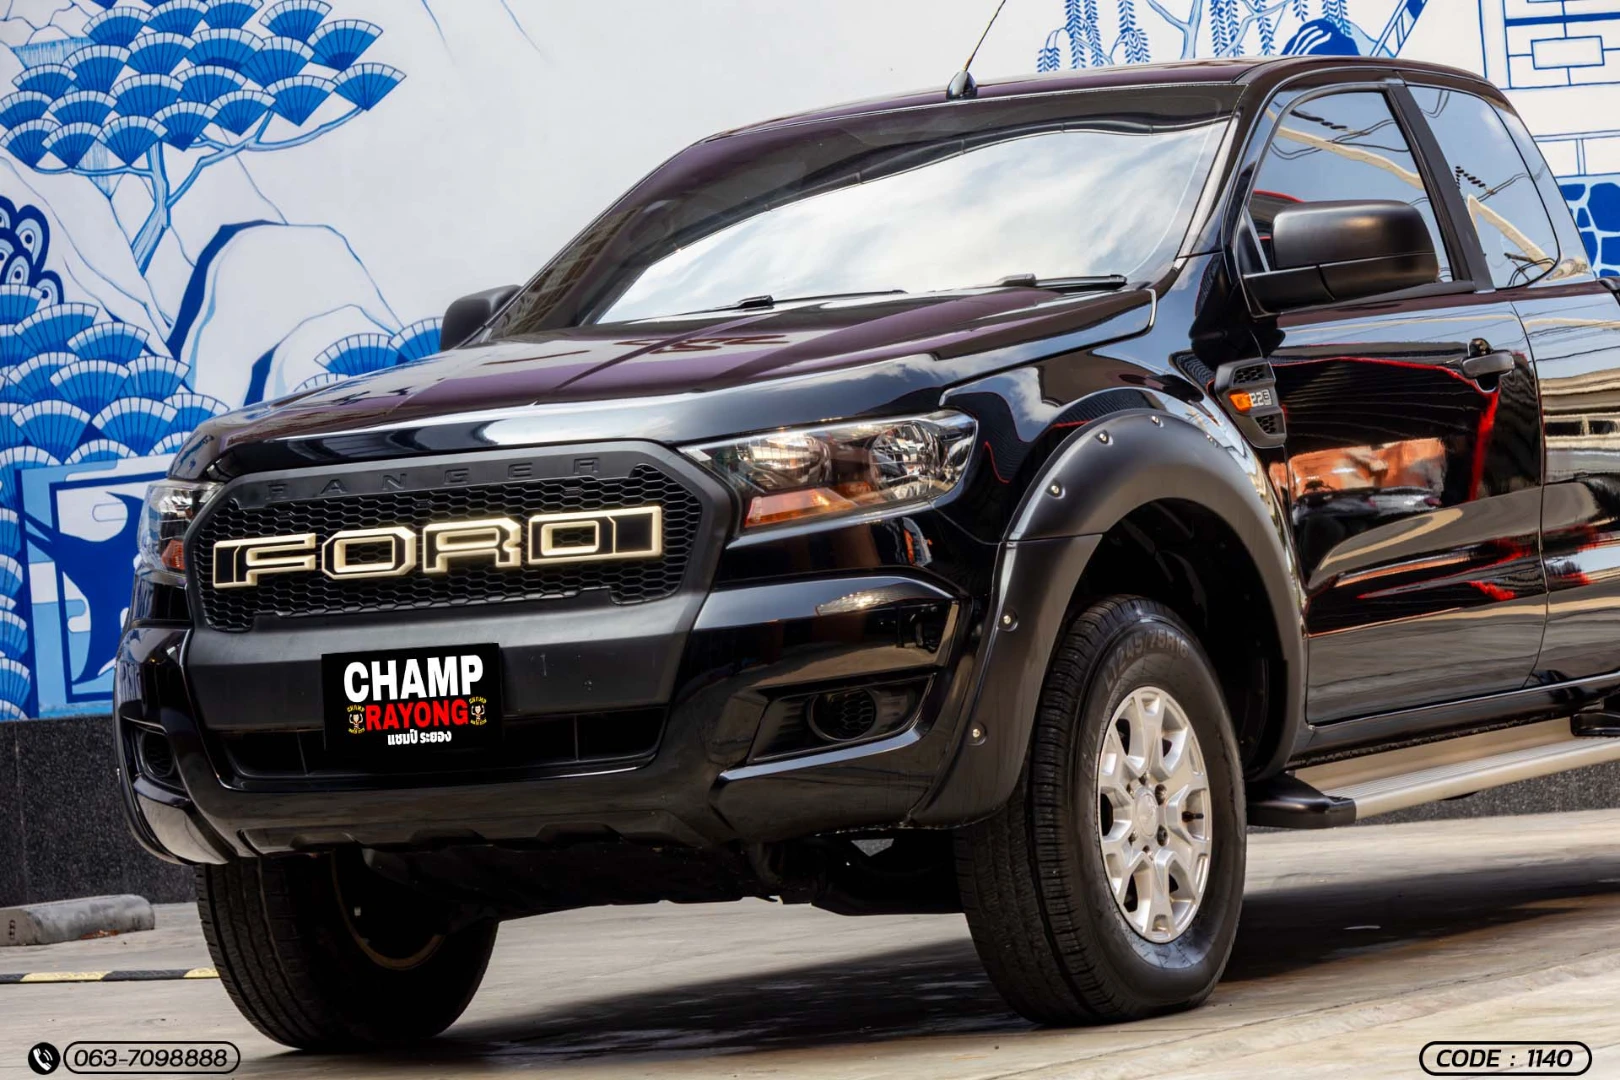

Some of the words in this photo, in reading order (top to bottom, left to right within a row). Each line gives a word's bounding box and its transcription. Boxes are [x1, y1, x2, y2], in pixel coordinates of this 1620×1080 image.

[267, 457, 600, 500] RANGER
[212, 505, 663, 589] FORD
[344, 654, 483, 703] CHAMP
[365, 699, 469, 731] RAYONG
[419, 731, 452, 744] ระยอง
